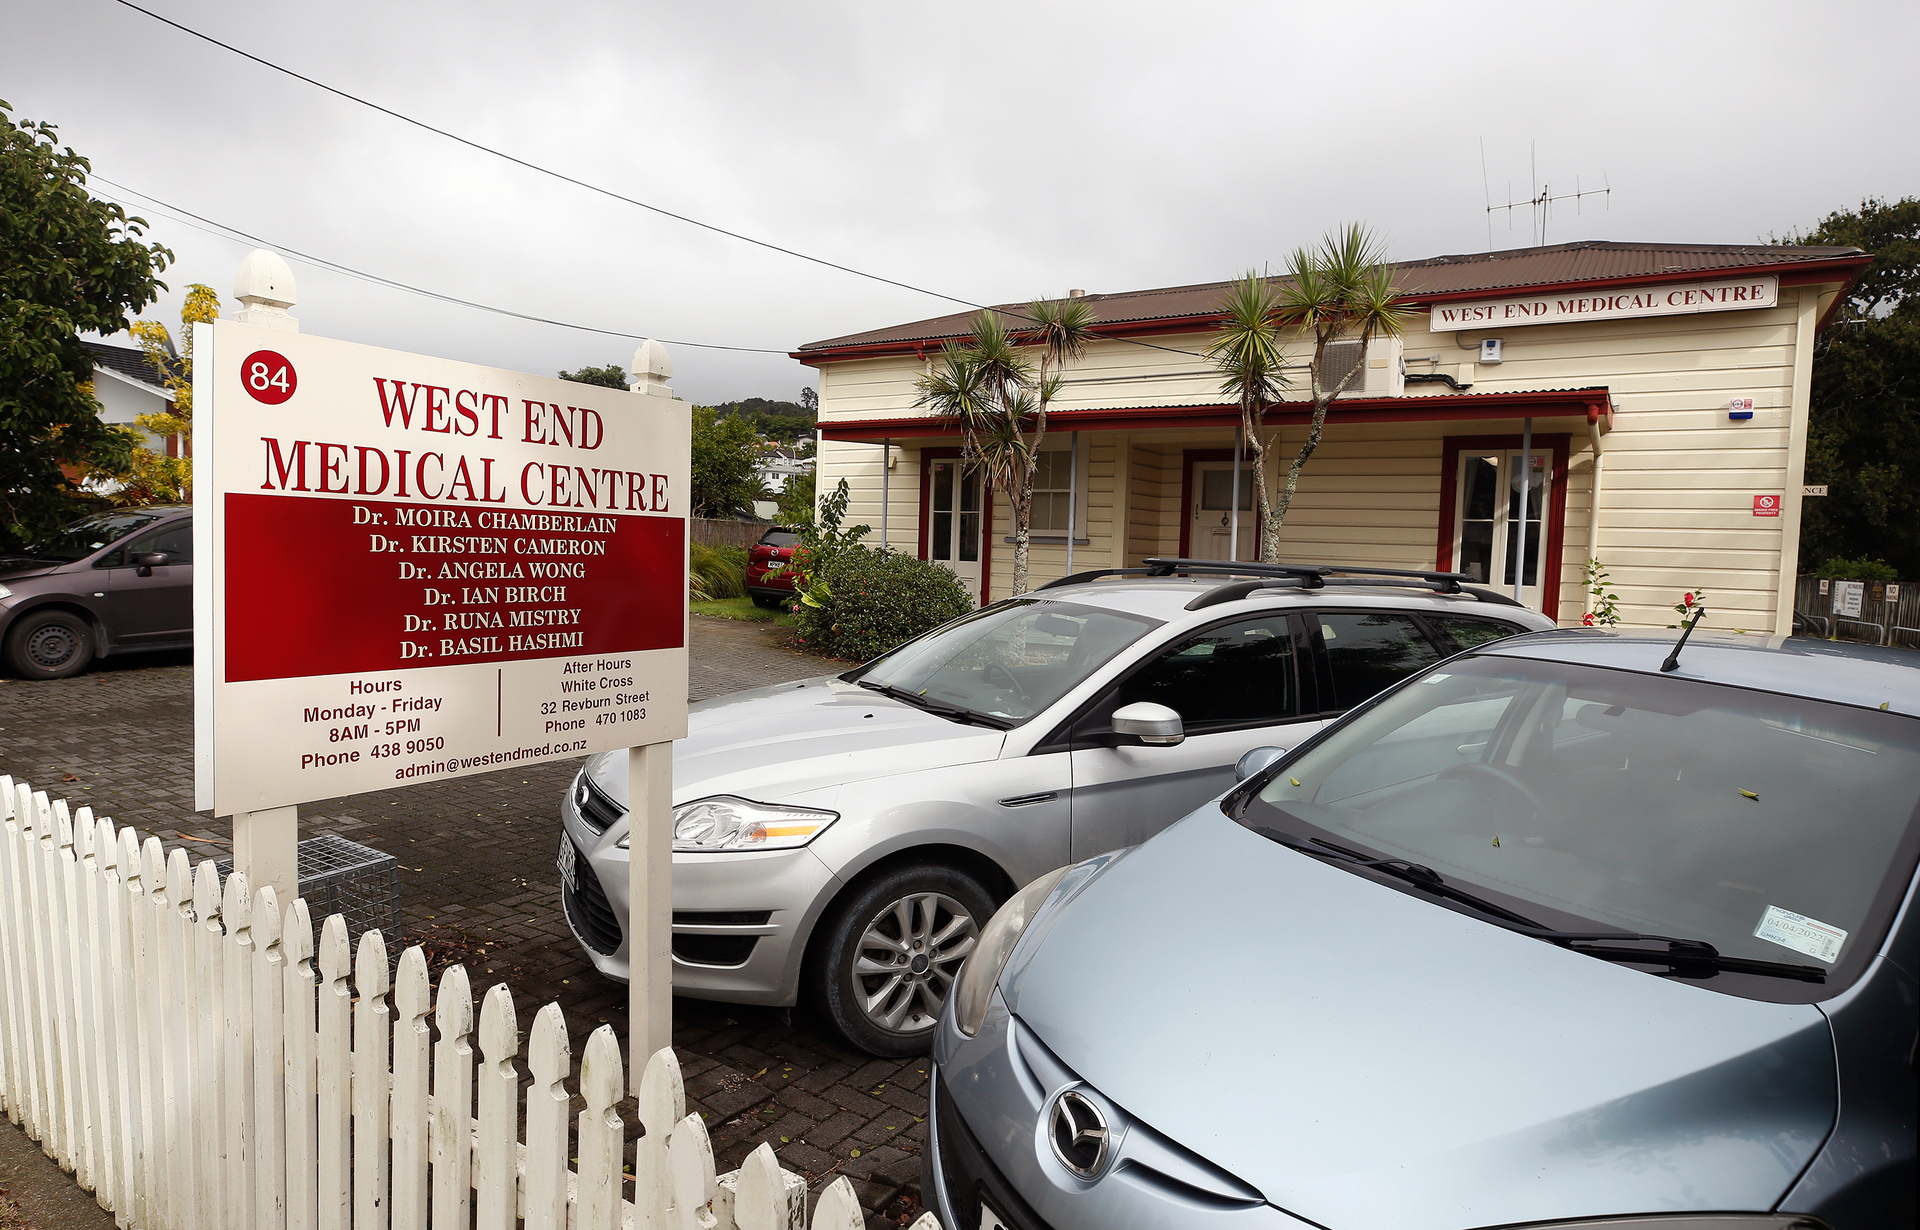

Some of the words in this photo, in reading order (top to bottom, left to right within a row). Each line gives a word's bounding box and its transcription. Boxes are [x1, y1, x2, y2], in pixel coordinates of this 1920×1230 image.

[1441, 306, 1498, 322] WEST
[1504, 303, 1547, 318] END
[1556, 294, 1659, 314] MEDICAL
[1667, 285, 1765, 305] CENTRE
[249, 362, 290, 393] 84
[373, 377, 509, 439] WEST
[521, 400, 604, 449] END
[261, 438, 506, 503] MEDICAL
[520, 461, 670, 512] CENTRE
[353, 506, 388, 527] Dr.
[395, 510, 471, 529] MOIRA
[478, 513, 617, 533] CHAMBERLAIN
[370, 535, 405, 553] Dr.
[411, 536, 508, 554] KIRSTEN
[514, 538, 606, 556] CAMERON
[399, 562, 432, 580] Dr.
[438, 563, 524, 579] ANGELA
[529, 563, 585, 578] WONG
[424, 588, 456, 606] Dr.
[461, 587, 499, 604] IAN
[505, 586, 566, 603] BIRCH
[404, 614, 437, 632] Dr.
[443, 612, 504, 630] RUNA
[509, 609, 582, 627] MISTRY
[400, 641, 433, 659] Dr.
[439, 637, 503, 656] BASIL
[508, 632, 584, 651] HASHMI
[563, 661, 593, 675] After
[596, 657, 631, 671] Hours
[350, 677, 402, 696] Hours
[561, 678, 597, 693] White
[600, 675, 633, 689] Cross
[303, 704, 376, 723] Monday
[392, 695, 443, 713] Friday
[541, 702, 557, 715] 32
[615, 690, 649, 705] Street
[329, 723, 368, 743] 8AM
[385, 718, 421, 737] 5PM
[545, 718, 585, 734] Phone
[595, 711, 616, 726] 470
[620, 707, 646, 722] 1083
[301, 748, 361, 770] Phone
[370, 742, 401, 759] 438
[406, 736, 444, 754] 9050
[395, 739, 587, 780] admin@westendmed.co.nz
[1767, 917, 1823, 942] 04/04/2022
